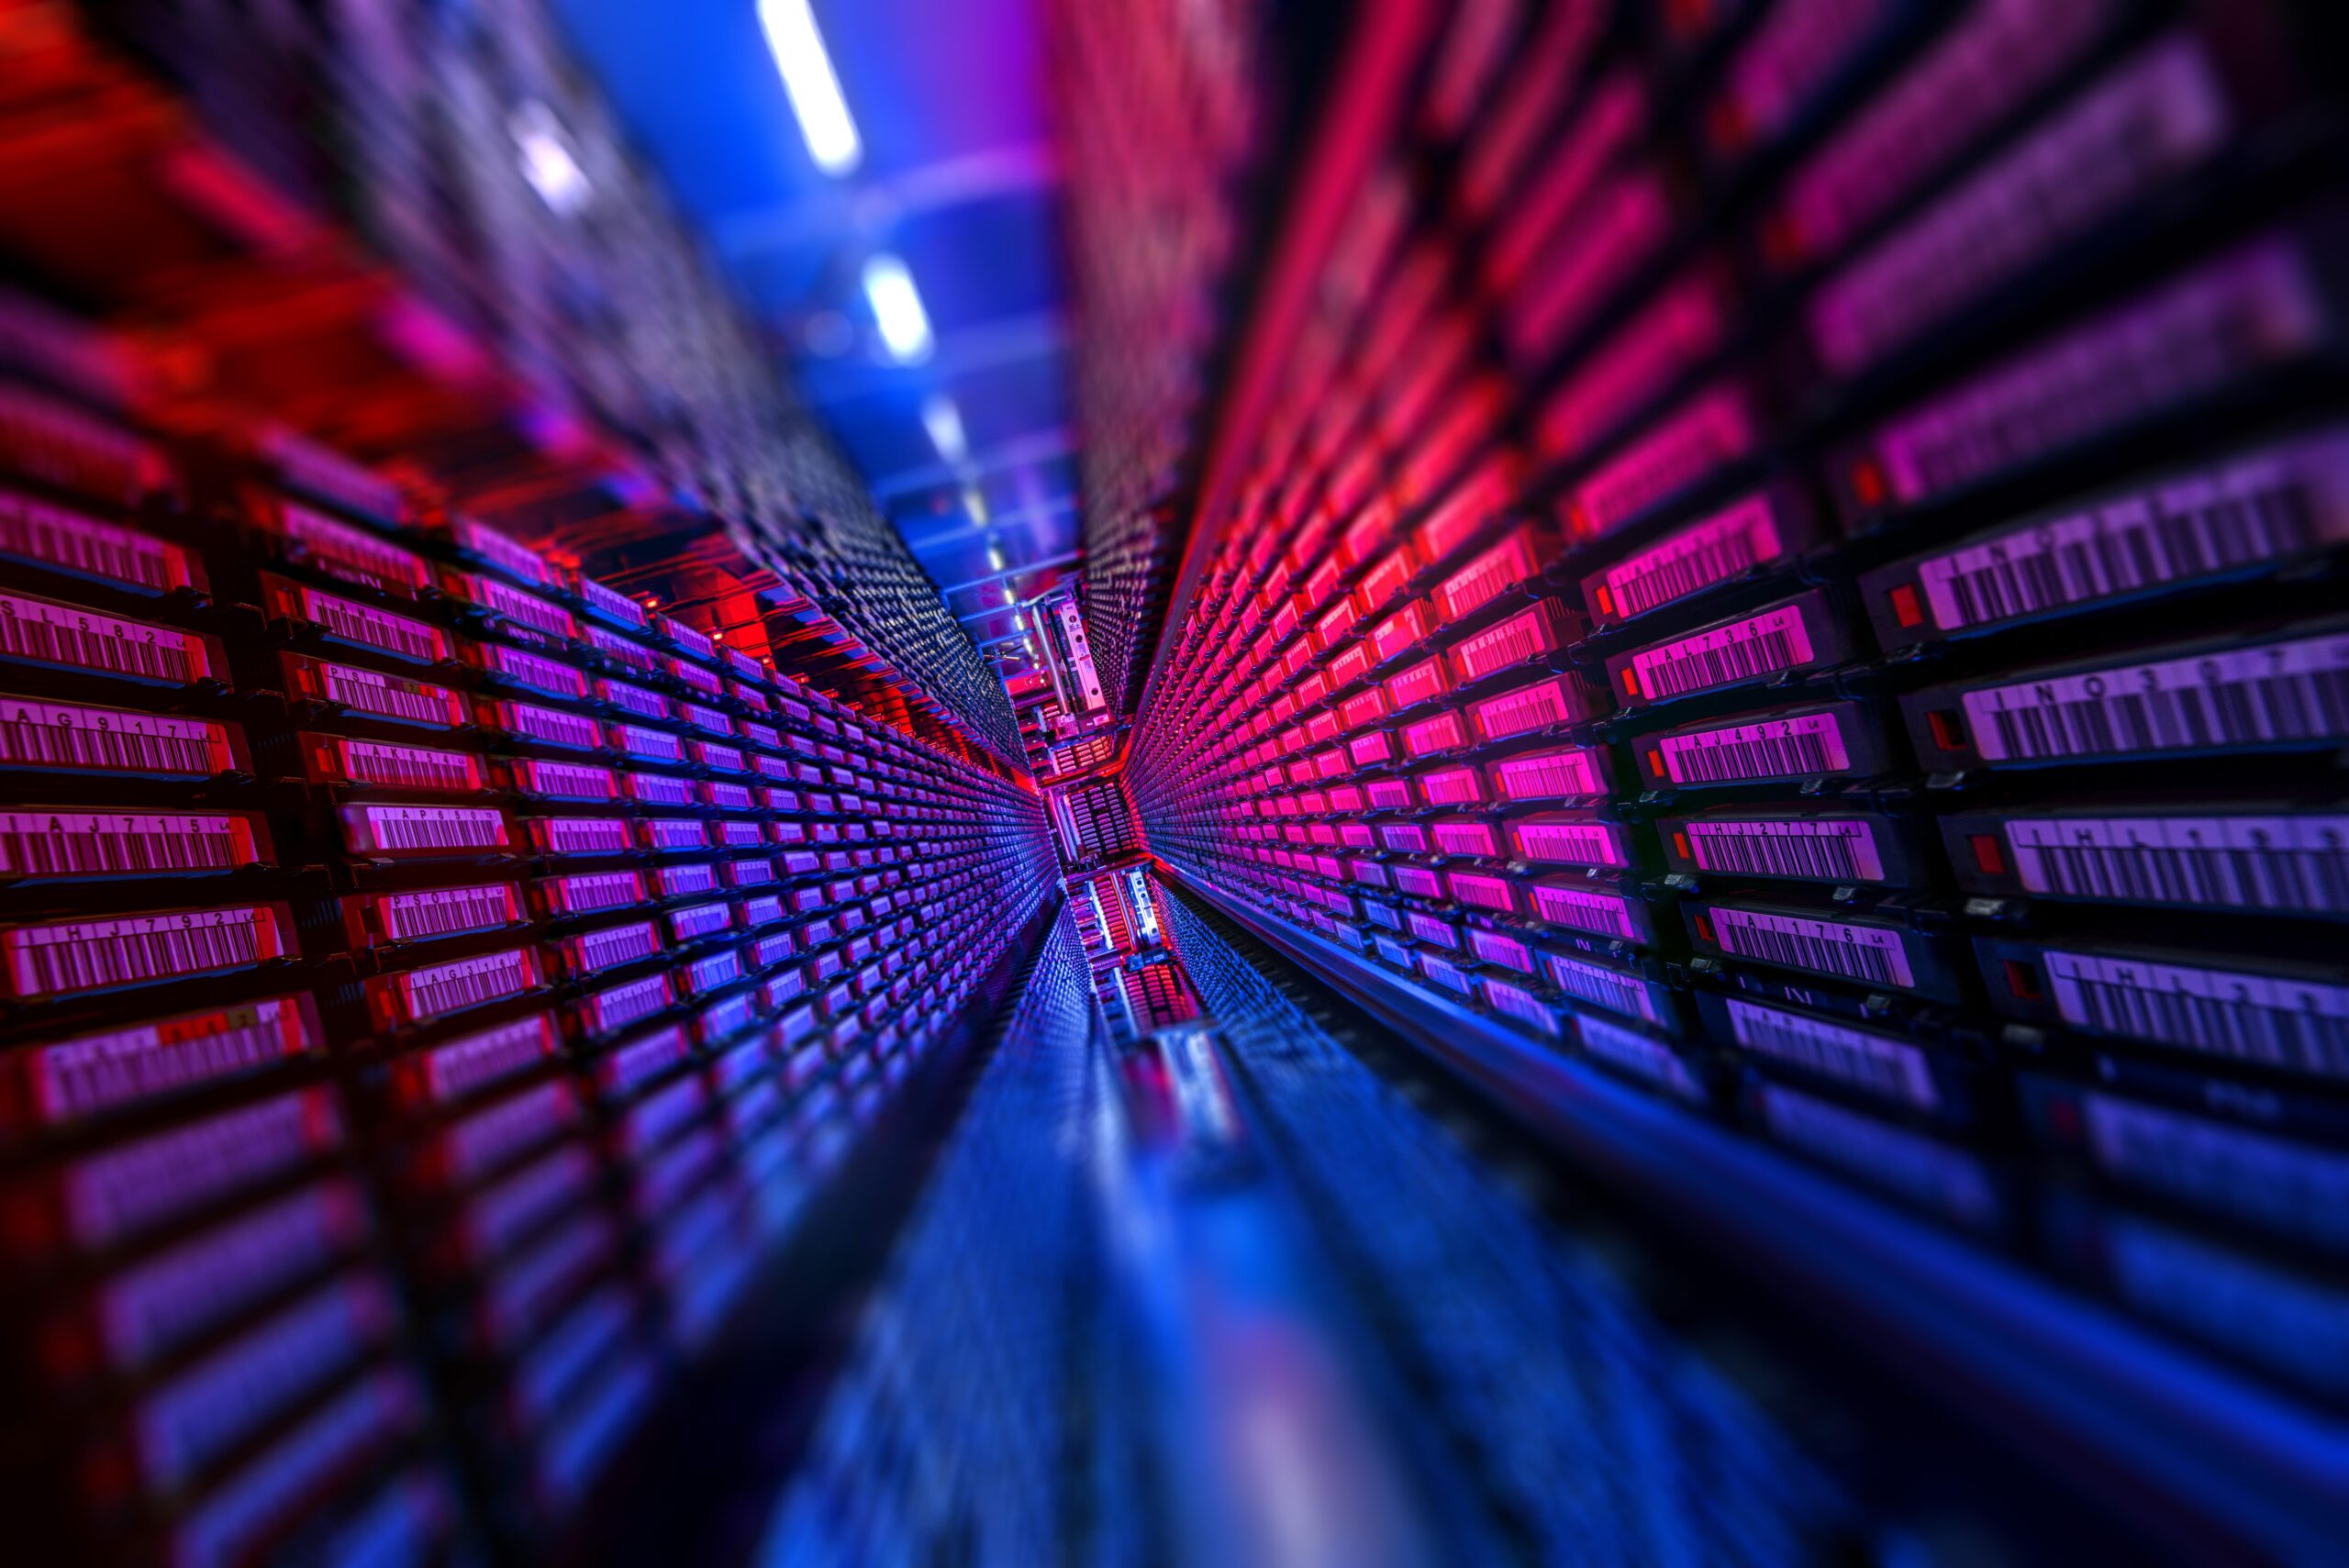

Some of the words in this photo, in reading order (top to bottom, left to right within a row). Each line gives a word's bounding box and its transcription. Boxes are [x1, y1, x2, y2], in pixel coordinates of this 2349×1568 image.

[1, 600, 155, 645] SL582
[1647, 622, 1758, 667] IAL736
[1774, 617, 1785, 628] L4
[17, 708, 177, 738] AG917
[1675, 721, 1792, 751] IAJ492
[1808, 720, 1820, 729] L4
[353, 742, 449, 765] IAK654
[8, 816, 200, 833] IAJ715
[383, 808, 477, 820] IAP650
[1696, 823, 1818, 836] IHJ277
[1838, 826, 1851, 836] L4
[27, 912, 225, 945] IHJ792
[1727, 911, 1854, 944] IAI176
[1871, 934, 1884, 944] L4
[412, 958, 506, 988] IAG316
